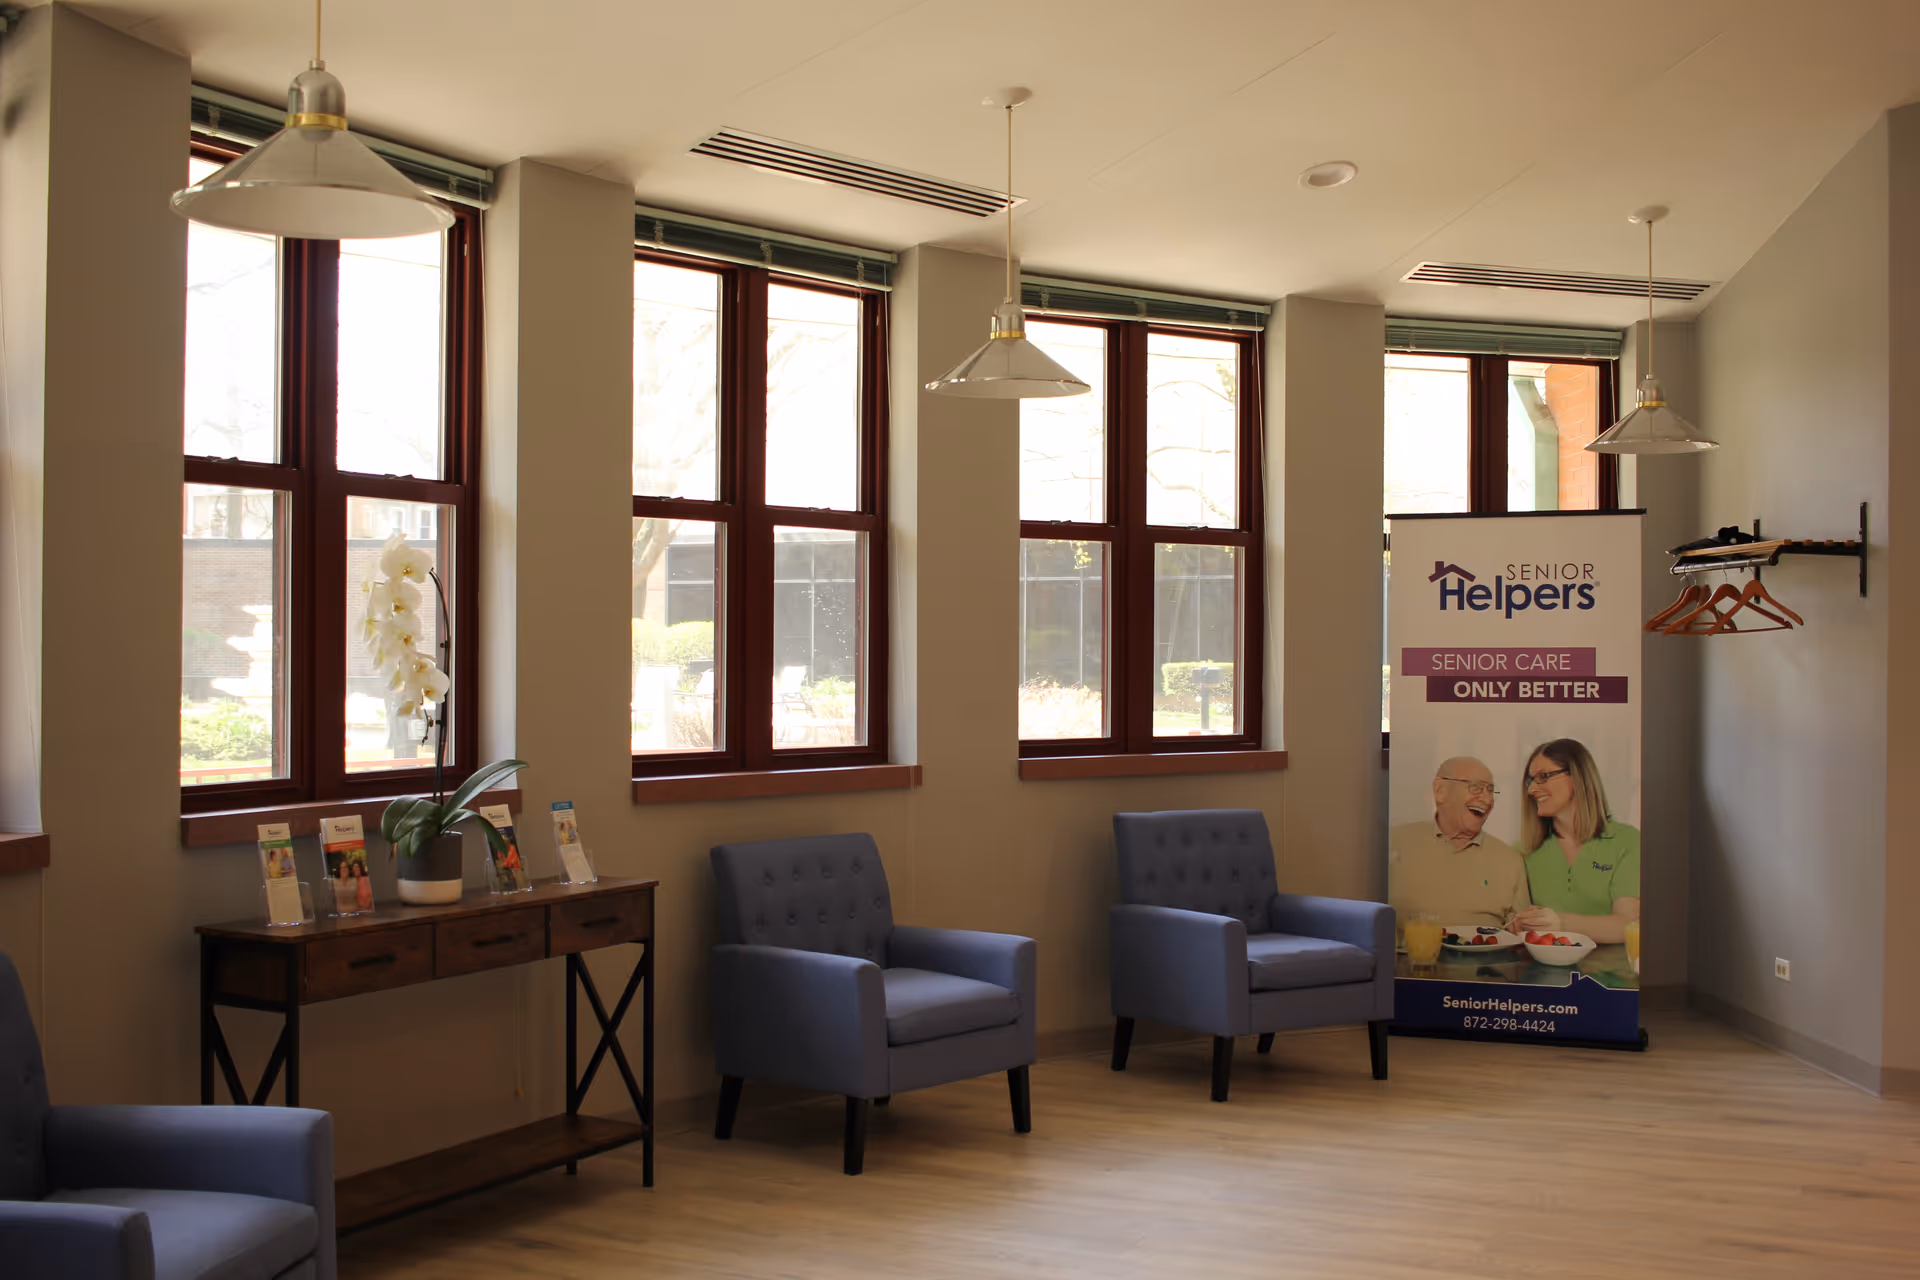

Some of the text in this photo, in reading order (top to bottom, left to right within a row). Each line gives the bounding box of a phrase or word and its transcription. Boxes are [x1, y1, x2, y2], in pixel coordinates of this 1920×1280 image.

[1506, 563, 1595, 580] SENIOR
[1439, 575, 1596, 619] Helpers
[1431, 653, 1571, 671] SENIOR CARE
[1453, 681, 1600, 699] ONLY BETTER
[1442, 995, 1579, 1015] SeniorHelpers.com
[1463, 1016, 1556, 1033] 872-298-4424
